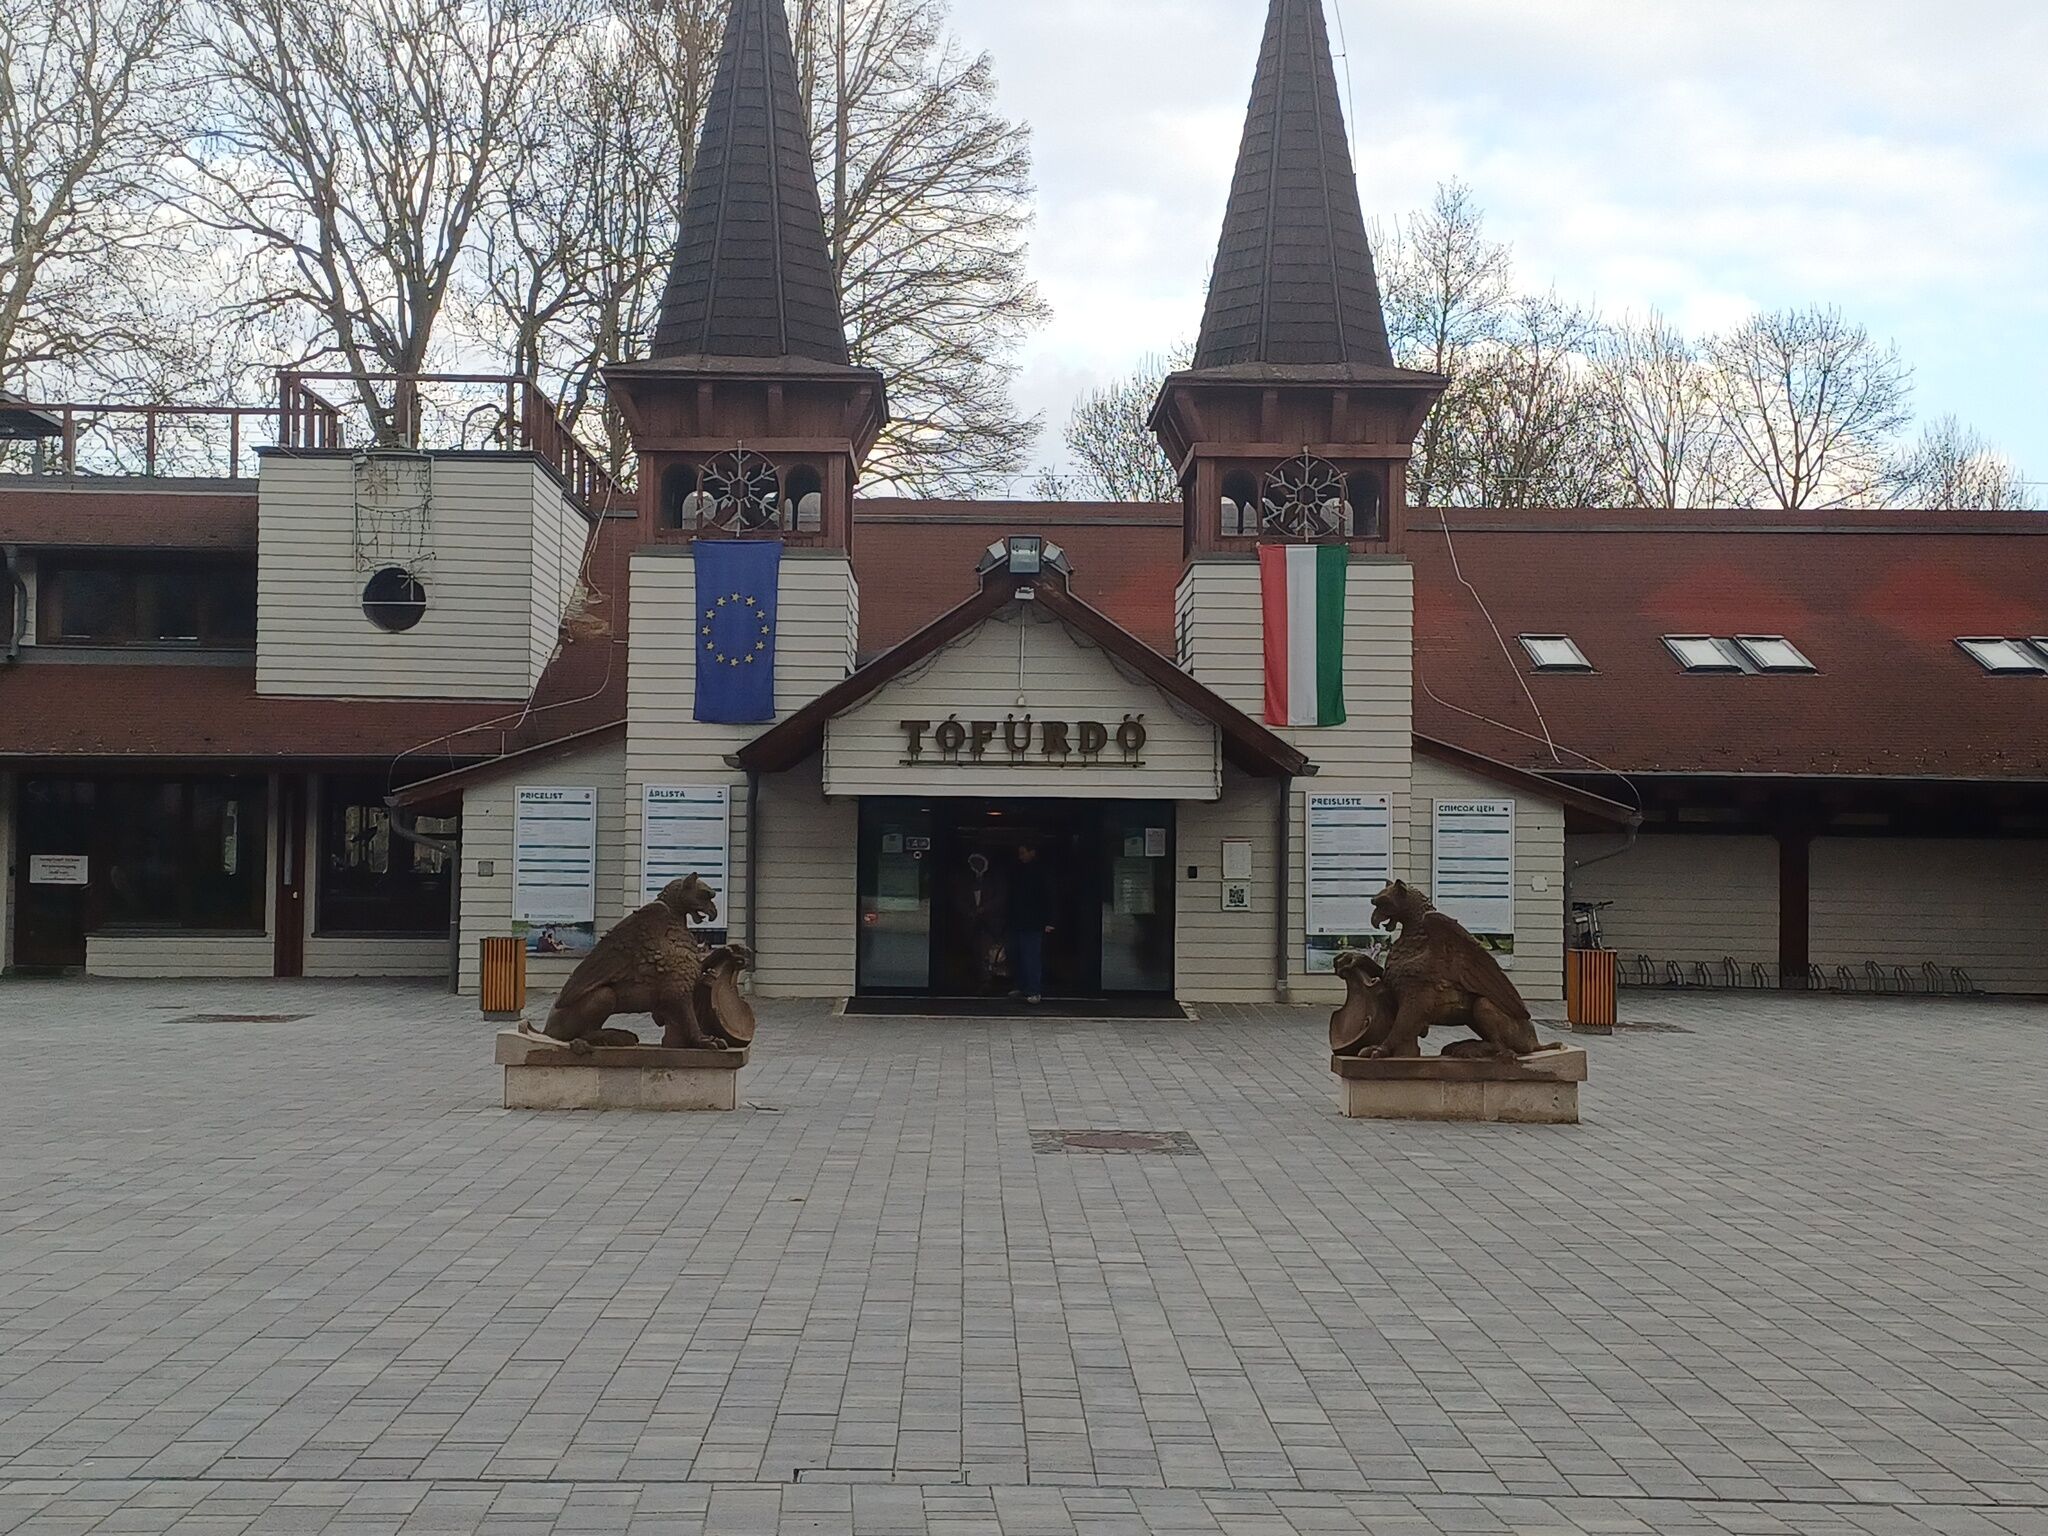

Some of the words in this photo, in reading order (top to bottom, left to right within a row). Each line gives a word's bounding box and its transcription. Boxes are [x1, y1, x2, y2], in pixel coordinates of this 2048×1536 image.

[900, 713, 1147, 755] TÓFÜRDŐ
[520, 792, 563, 800] PRICELIST
[648, 789, 686, 798] ÁRLISTA
[1311, 798, 1362, 806] PREISLISTE
[1476, 805, 1495, 813] ЦЕН
